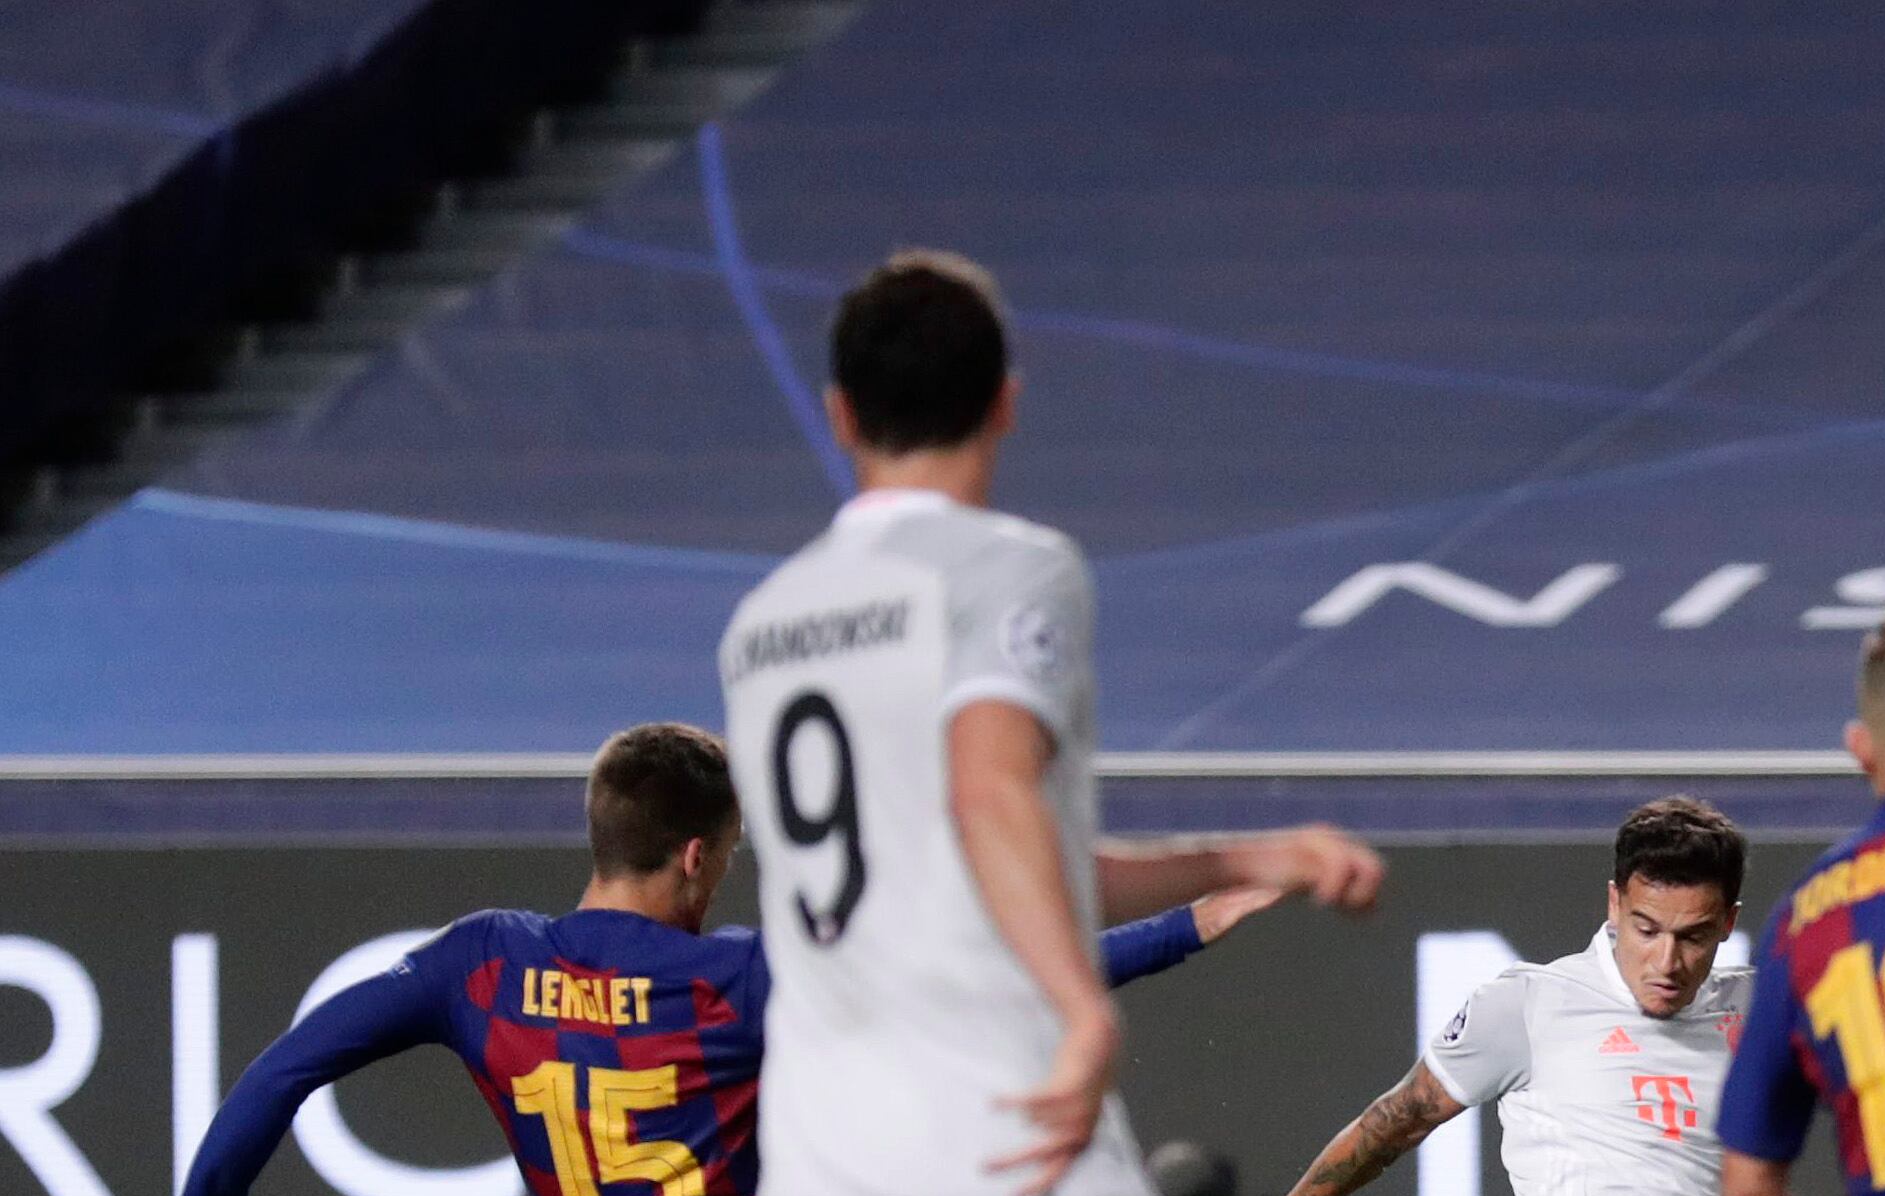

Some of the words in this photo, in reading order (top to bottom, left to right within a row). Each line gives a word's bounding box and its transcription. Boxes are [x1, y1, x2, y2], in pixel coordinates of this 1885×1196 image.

[728, 597, 910, 682] WANDOWSKI
[773, 691, 867, 946] 9
[522, 966, 653, 1026] LENGLET
